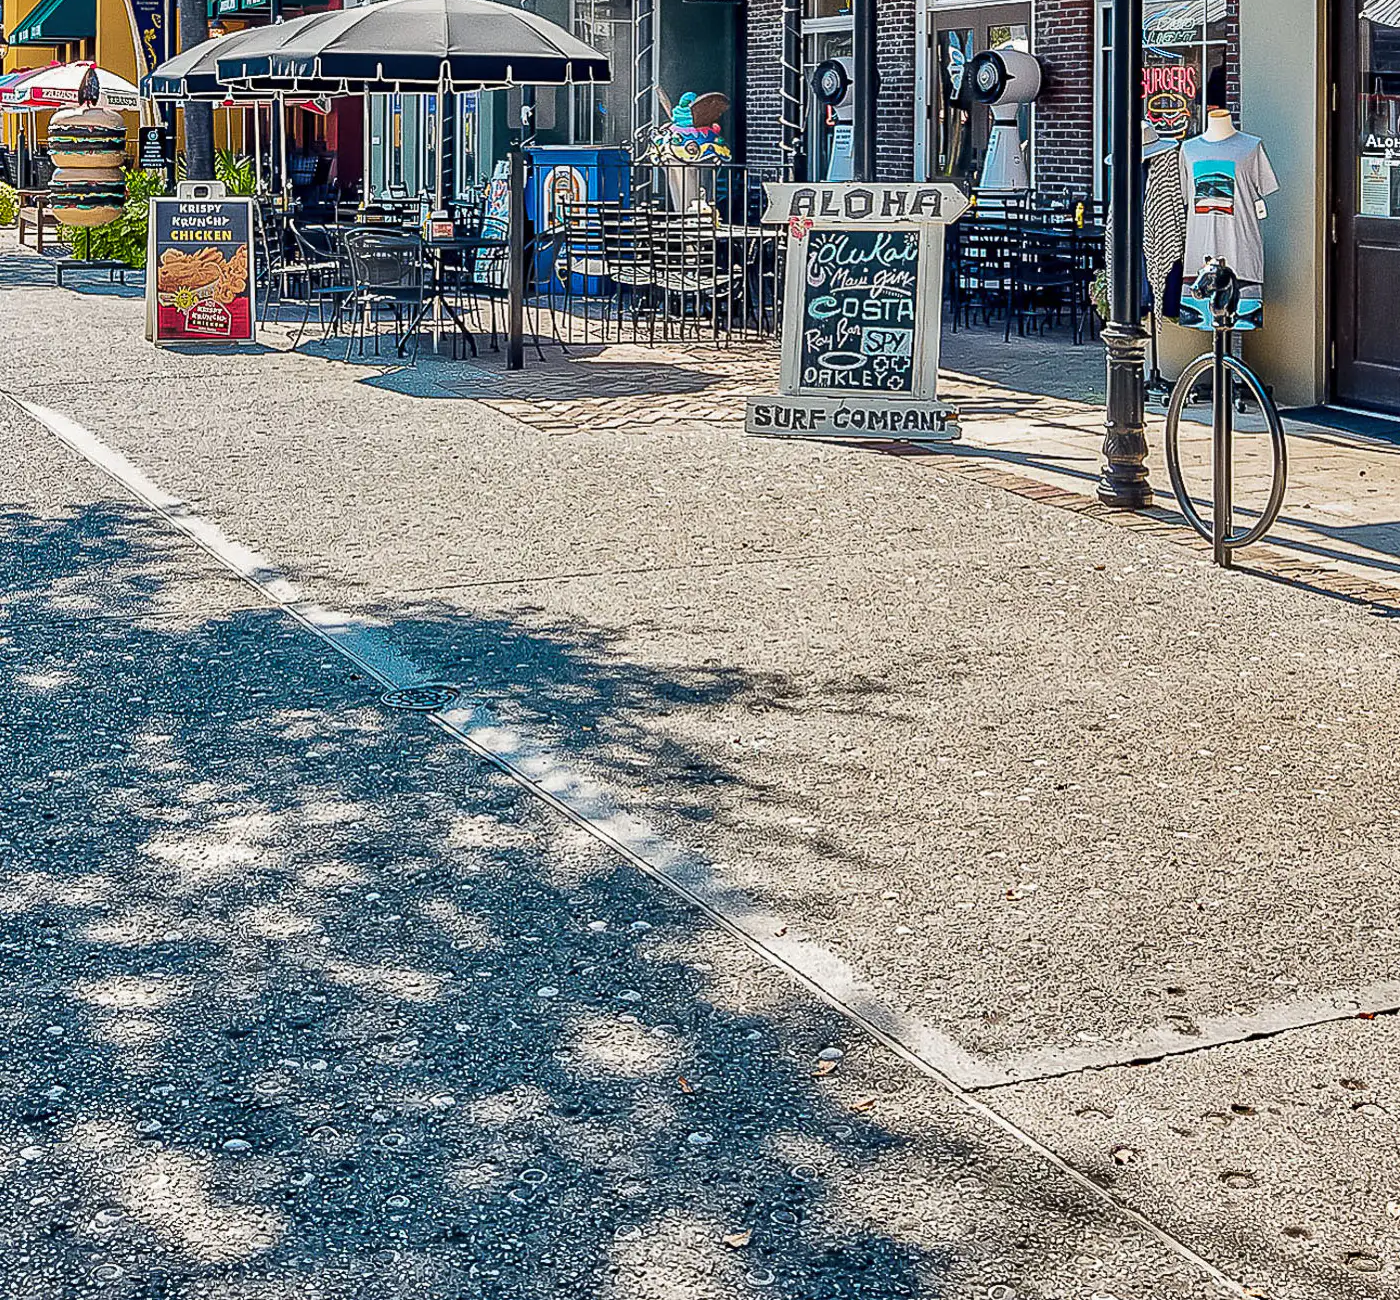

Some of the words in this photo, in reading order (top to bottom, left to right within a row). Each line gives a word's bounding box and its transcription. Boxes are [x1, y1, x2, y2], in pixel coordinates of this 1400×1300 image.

[42, 90, 79, 101] TABASC
[179, 203, 222, 214] KRISPY
[789, 188, 942, 219] ALOHA
[172, 215, 230, 228] KRUNCHY
[170, 230, 232, 241] CHICKEN
[808, 295, 914, 322] COSTA
[805, 328, 834, 354] Ray
[836, 317, 861, 349] Ban
[865, 331, 909, 352] SPY
[804, 366, 888, 388] OAKLEY
[754, 404, 826, 430] SURF
[833, 406, 951, 432] COMPANY
